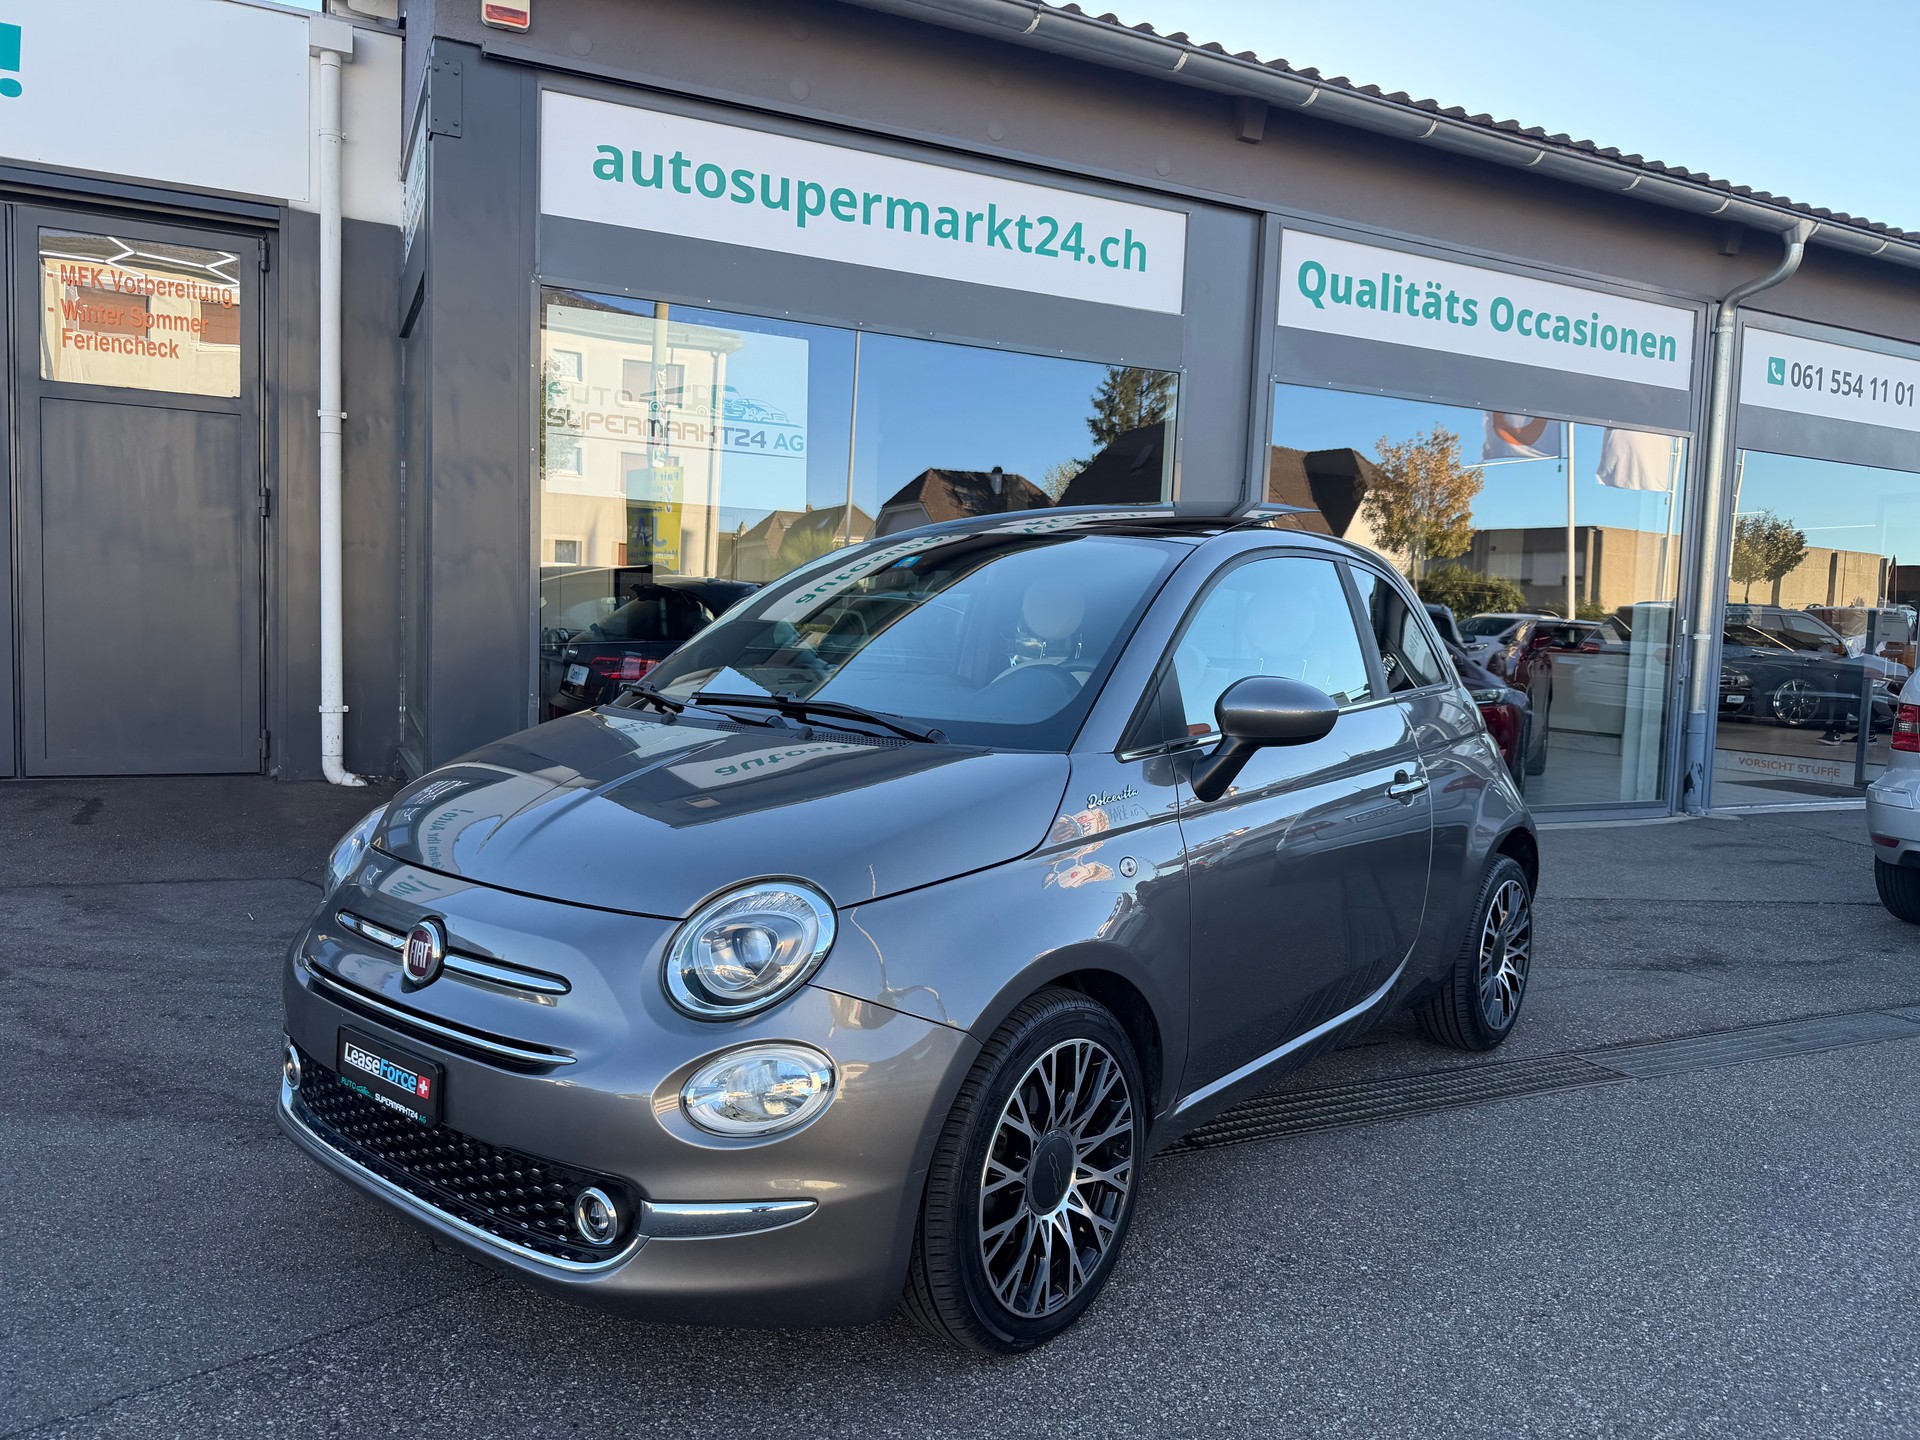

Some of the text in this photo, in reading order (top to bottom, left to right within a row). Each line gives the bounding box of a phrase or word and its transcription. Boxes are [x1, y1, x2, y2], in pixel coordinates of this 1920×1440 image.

[592, 143, 1147, 272] autosupermarkt24.ch
[60, 263, 232, 308] MFK Vorbereitung
[60, 298, 208, 335] Winter Sommer
[1298, 260, 1676, 362] Qualitäts Occasionen
[61, 327, 180, 359] Feriencheck
[1790, 362, 1915, 407] 061 554 11 01
[773, 433, 805, 452] AG
[1738, 757, 1840, 777] VORSICHT STUFFE
[410, 939, 431, 969] FIAT
[341, 1077, 357, 1089] AUTO
[344, 1042, 417, 1092] LeaseForce
